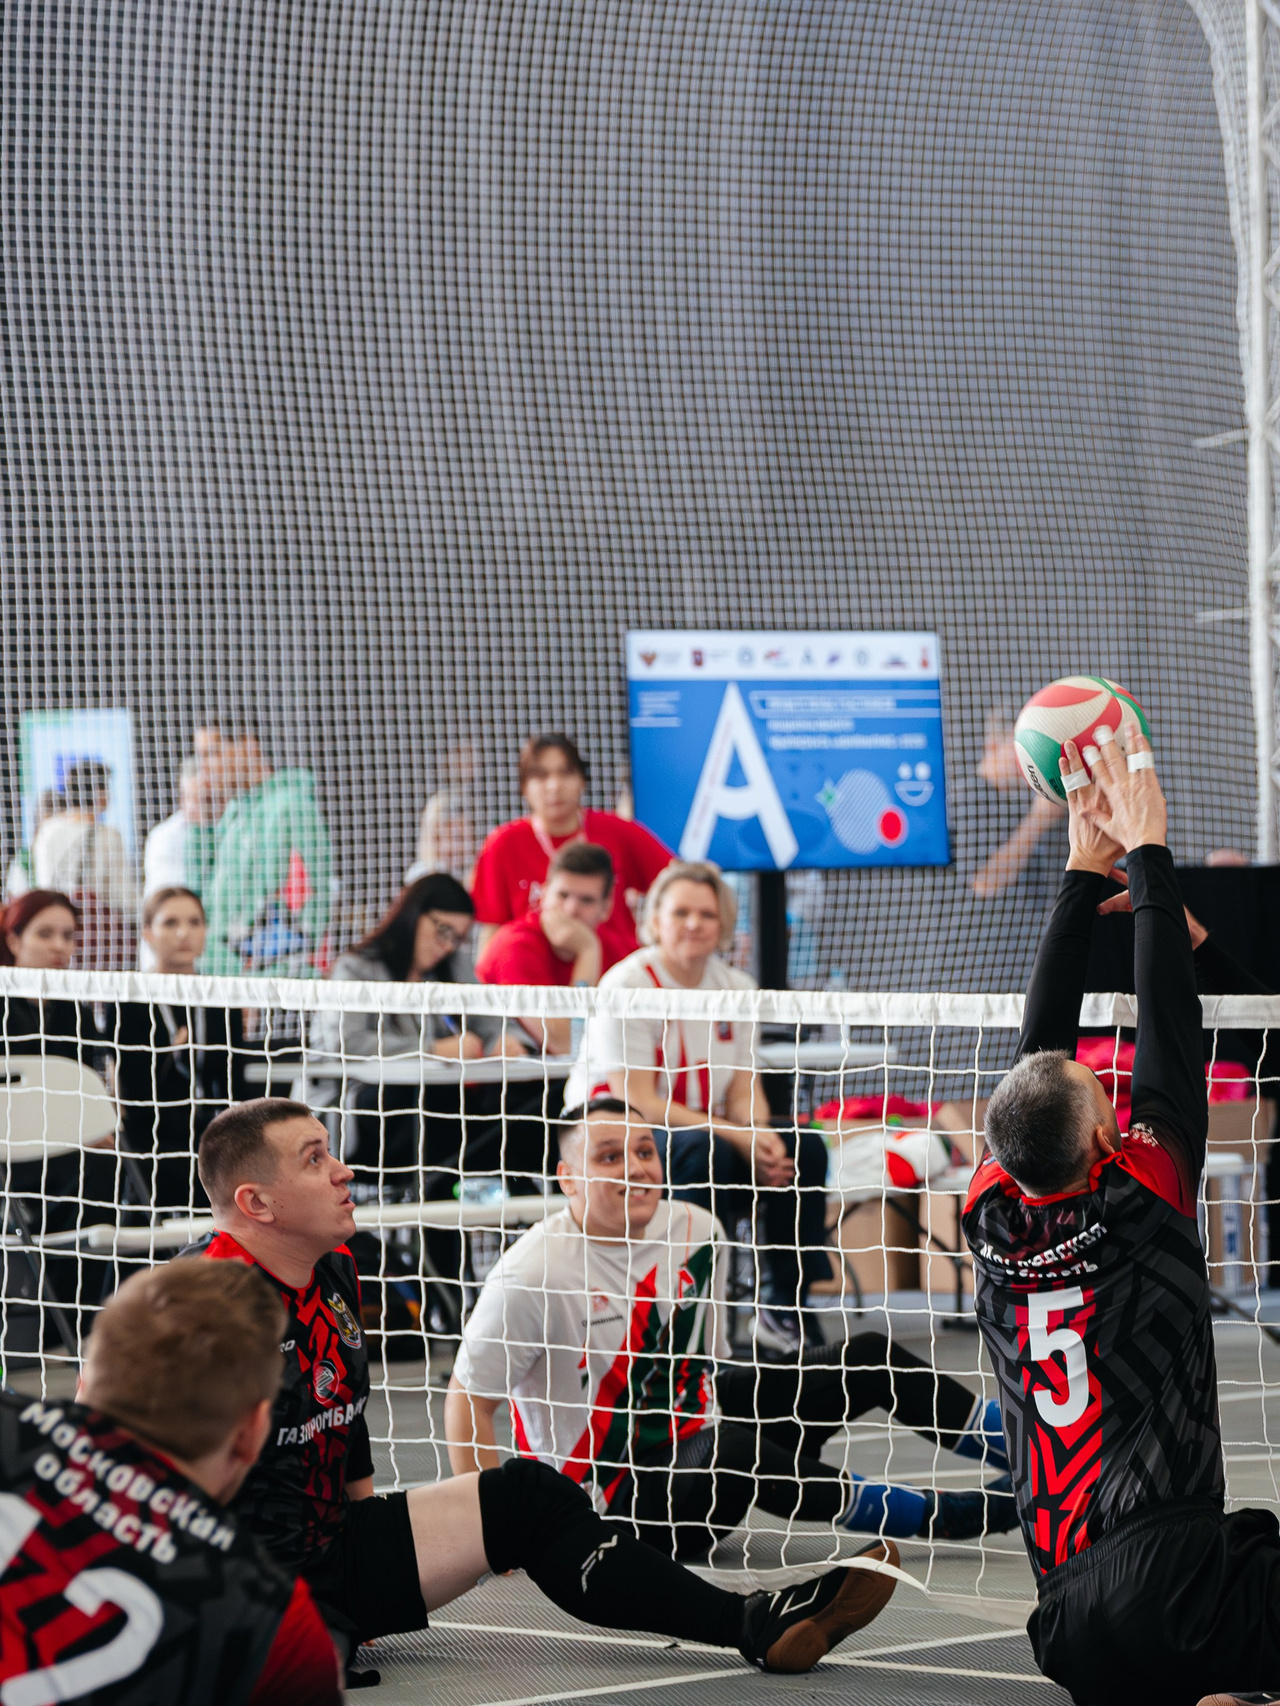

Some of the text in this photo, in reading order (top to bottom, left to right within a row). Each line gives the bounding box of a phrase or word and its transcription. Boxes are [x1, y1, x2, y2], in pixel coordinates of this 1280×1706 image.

[1028, 1286, 1089, 1428] 5
[20, 1400, 236, 1550] Московская
[33, 1453, 178, 1565] область
